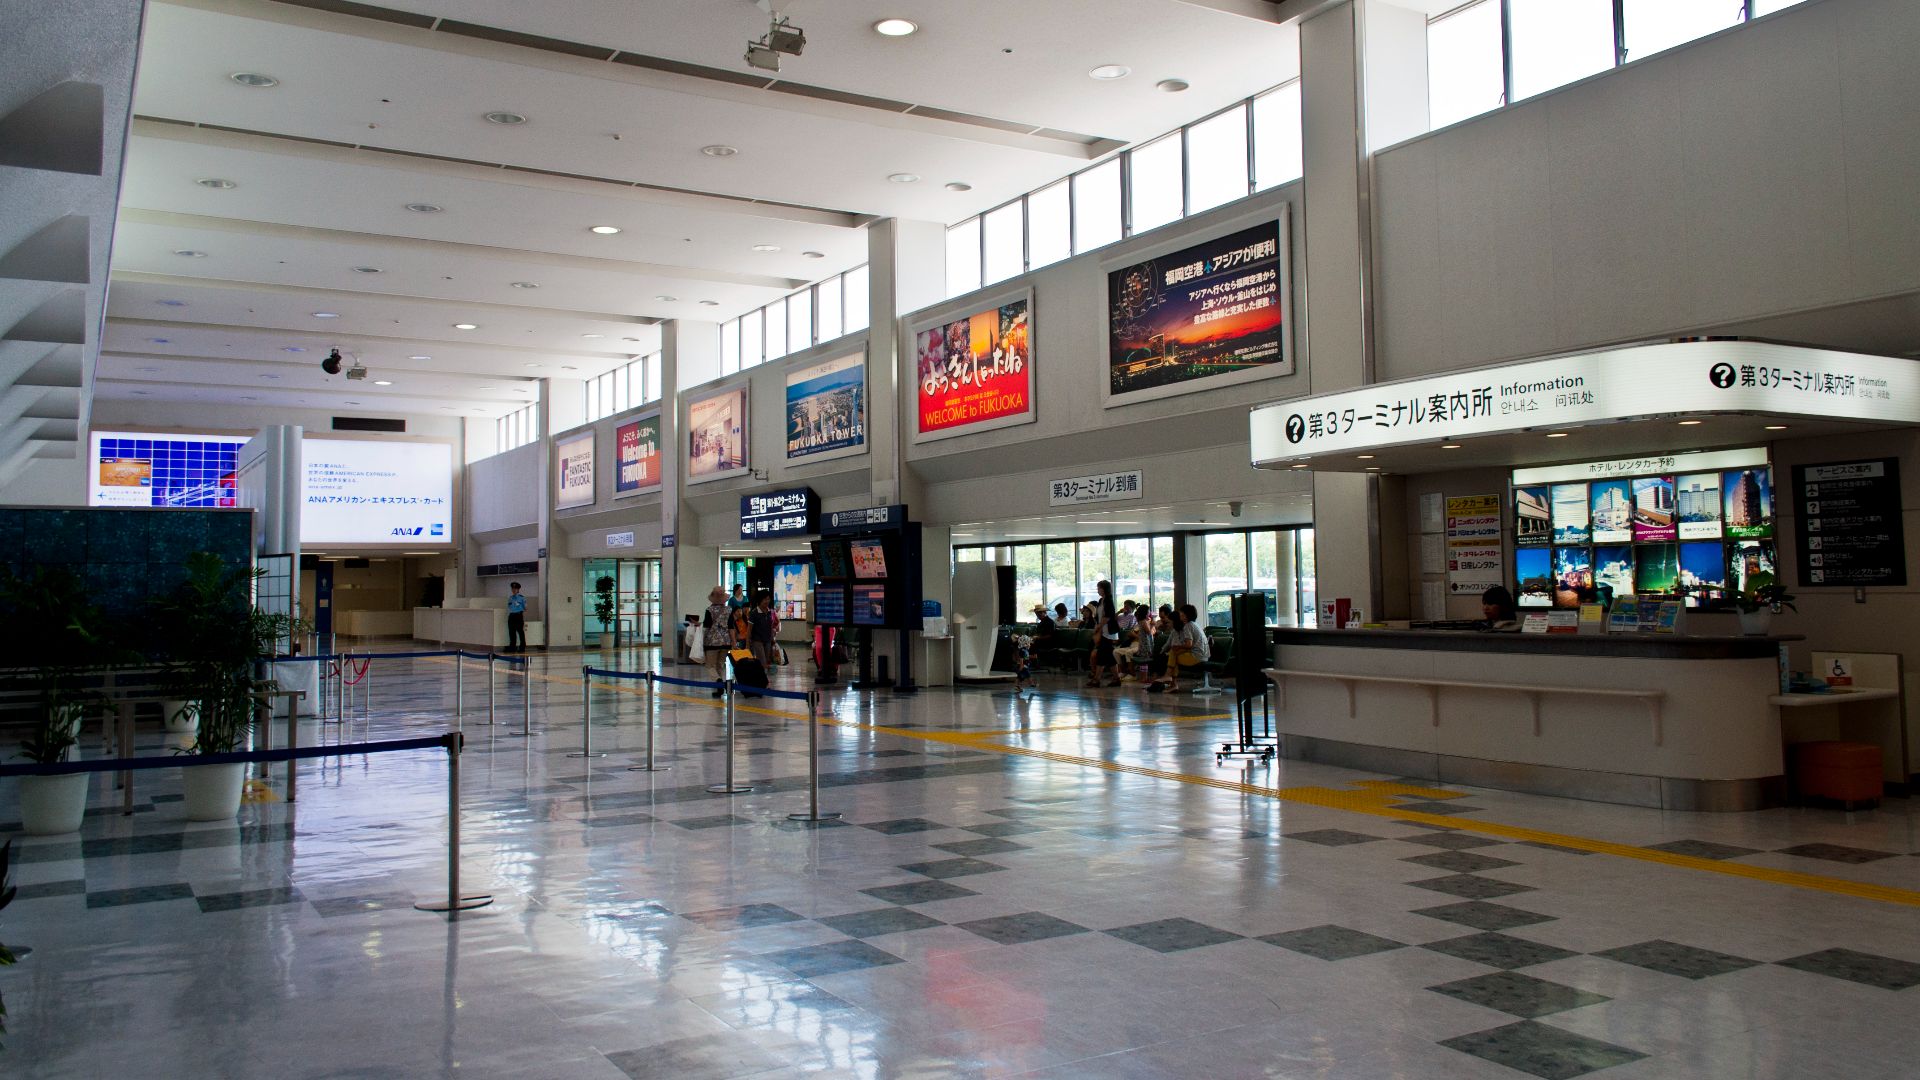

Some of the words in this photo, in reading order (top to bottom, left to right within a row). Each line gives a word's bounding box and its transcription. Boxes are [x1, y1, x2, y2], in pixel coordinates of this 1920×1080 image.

[1165, 261, 1204, 286] 福岡空港
[1212, 238, 1276, 272] アジアが便利
[1500, 375, 1584, 397] Information
[1740, 364, 1855, 396] 第3ターミナル案内所
[925, 404, 968, 426] WELCOME
[969, 404, 977, 417] to
[979, 392, 1023, 415] FUKUOKA
[1501, 398, 1538, 415] 안내소
[1555, 390, 1594, 408] 问讯处
[1308, 386, 1493, 439] 第3ターミナル案内所
[789, 433, 828, 451] FUKUOKA
[831, 425, 863, 441] TOWER
[622, 443, 647, 463] Welcome
[648, 440, 655, 456] to
[1589, 457, 1675, 473] ホテル・レンタカー予約
[1053, 474, 1137, 498] 第3ターミナル到着
[391, 527, 413, 536] ANA
